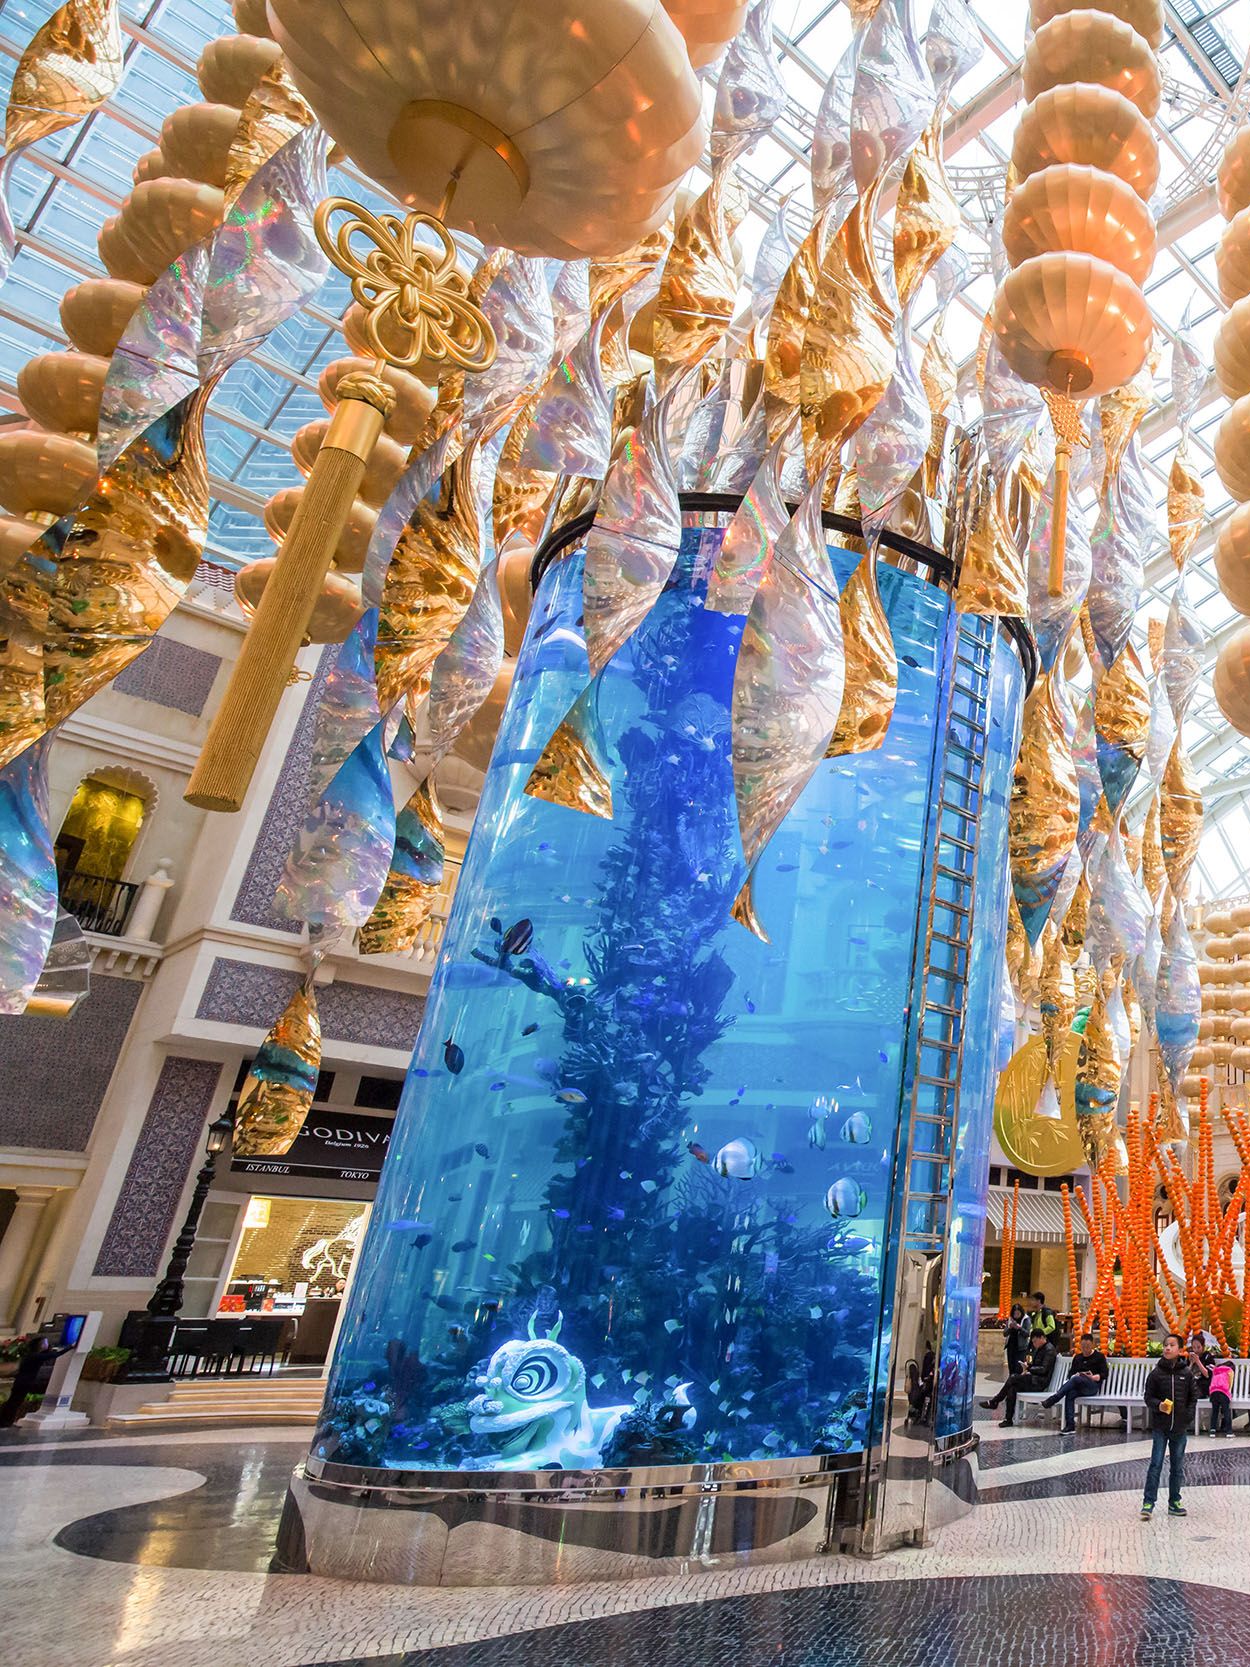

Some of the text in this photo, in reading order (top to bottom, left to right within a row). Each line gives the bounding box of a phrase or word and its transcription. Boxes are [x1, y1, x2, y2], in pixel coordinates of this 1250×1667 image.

[324, 1139, 352, 1148] Belgium
[245, 1163, 370, 1180] ISTANBUL TOKYO
